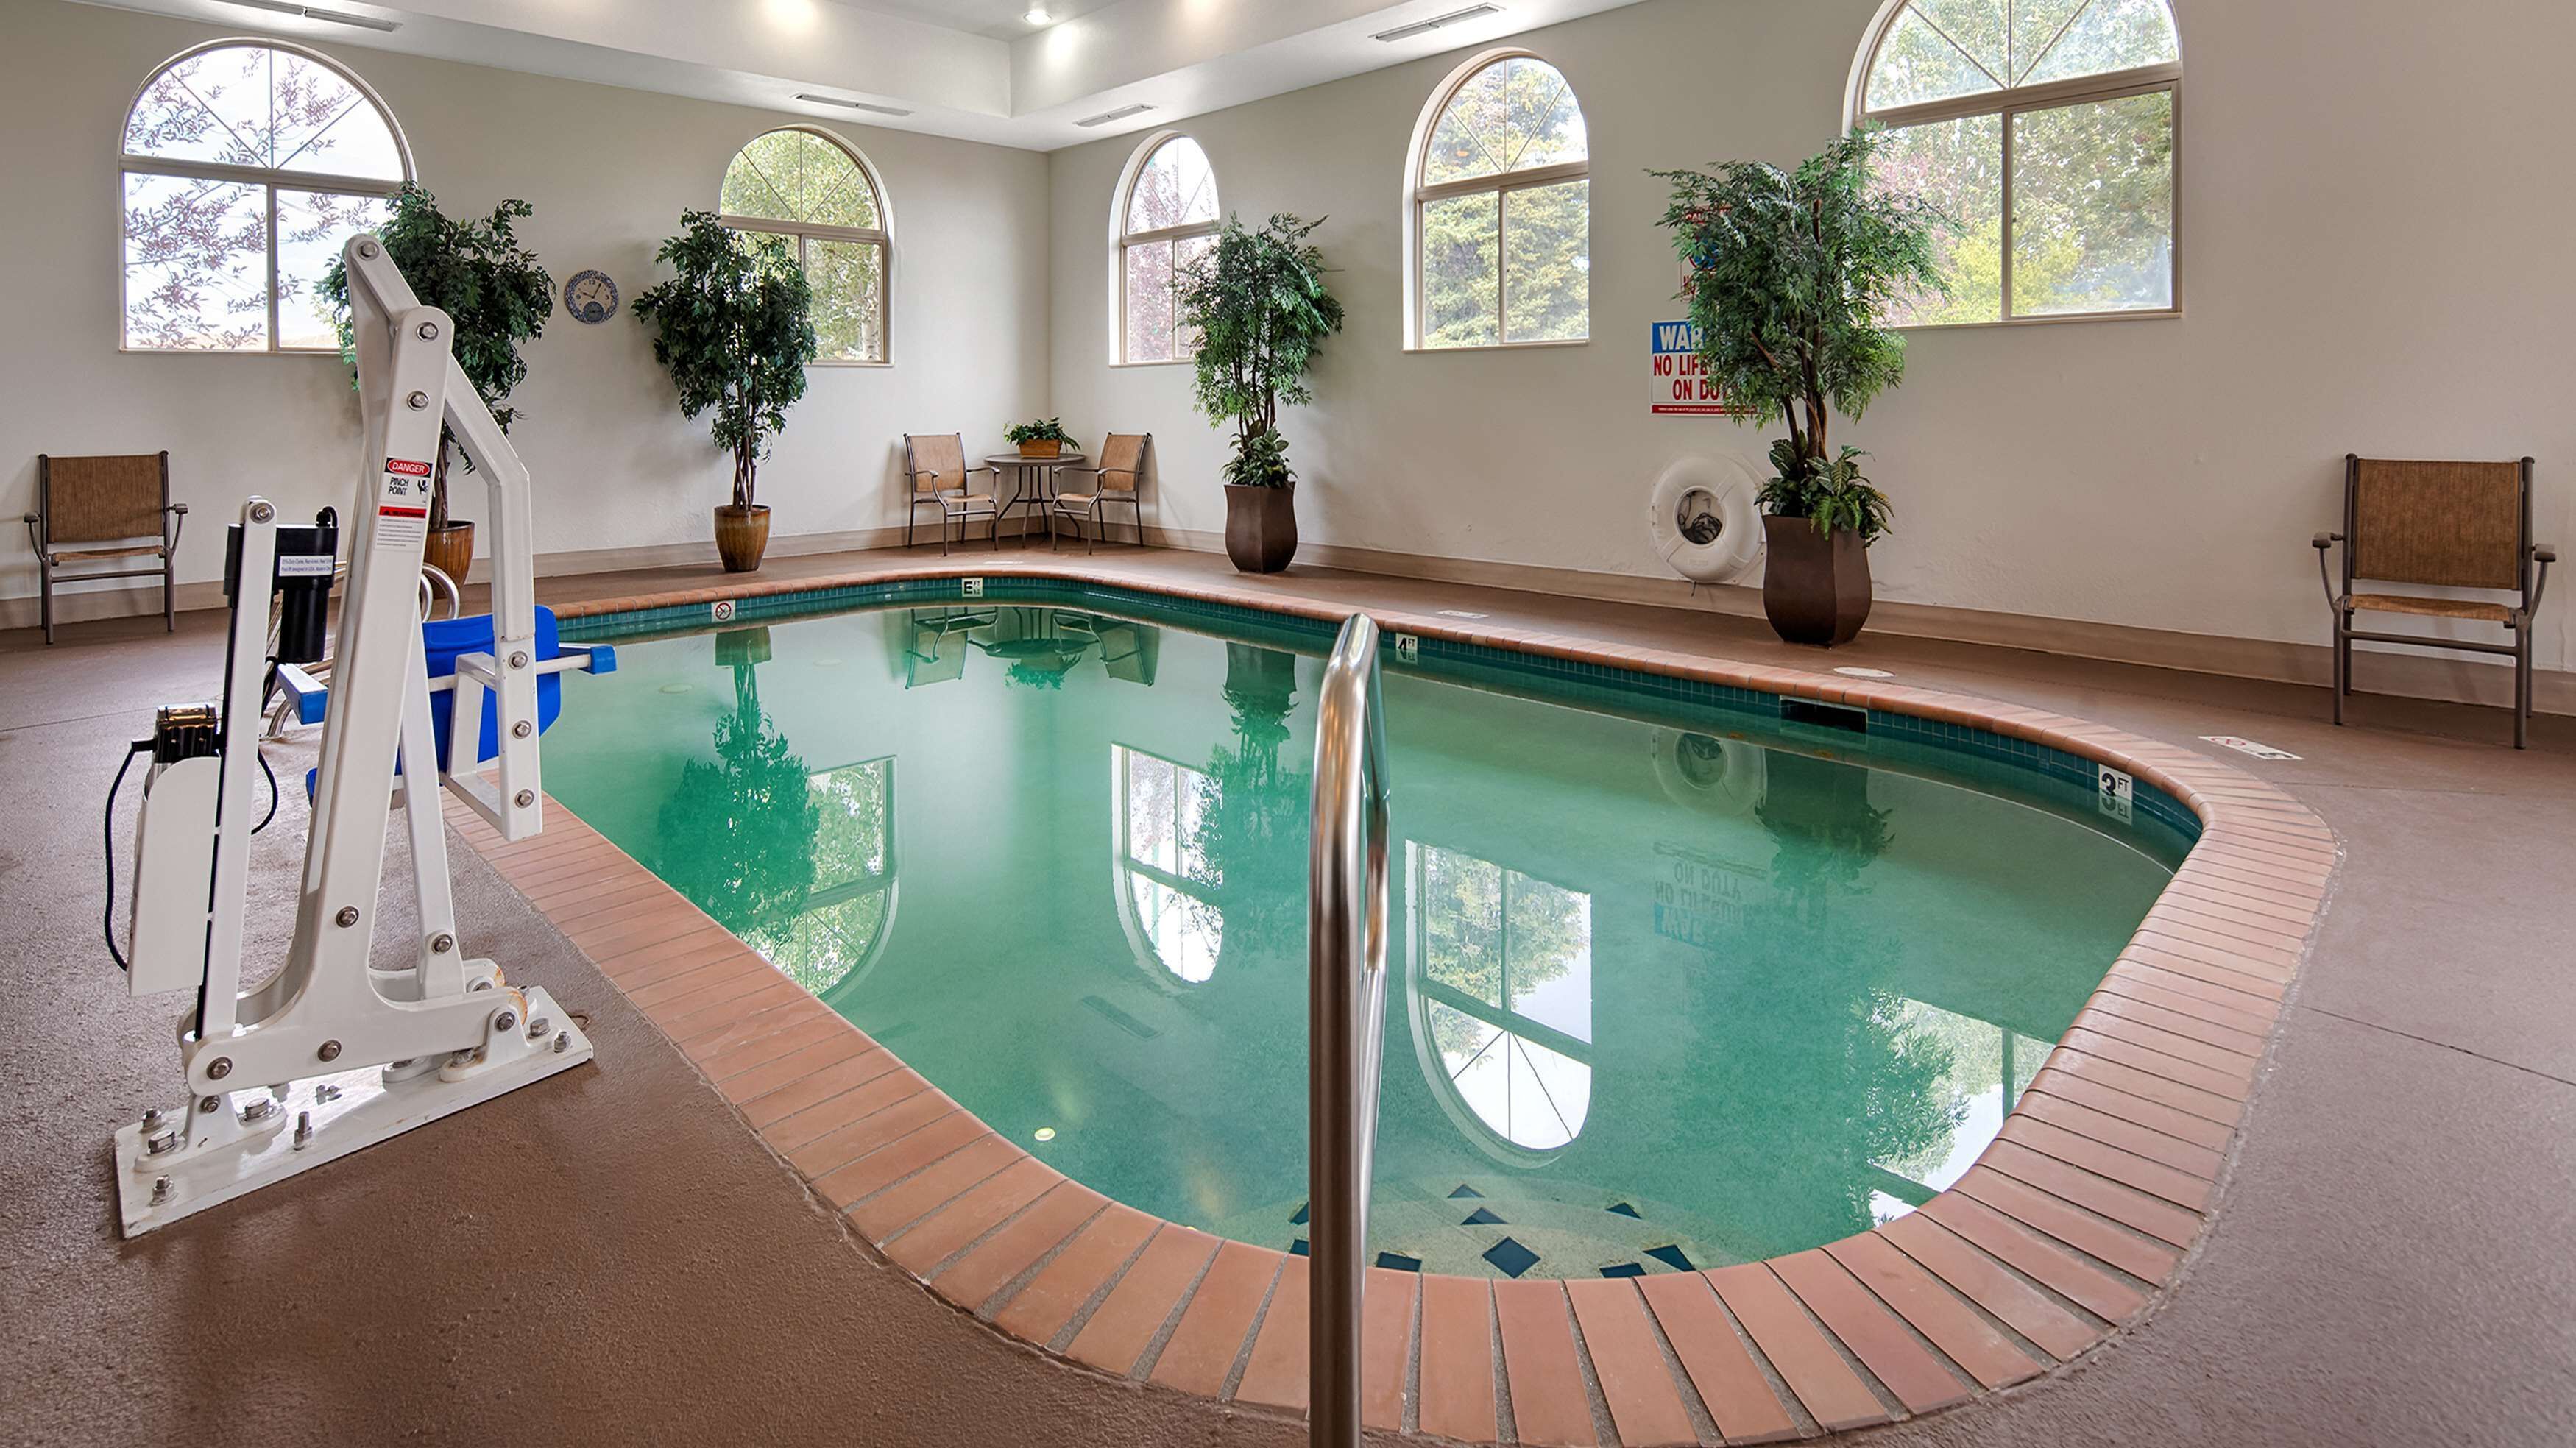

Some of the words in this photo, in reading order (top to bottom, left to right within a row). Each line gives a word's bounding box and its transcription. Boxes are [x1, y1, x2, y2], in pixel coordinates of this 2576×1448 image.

[1654, 355, 1672, 376] NO
[1672, 379, 1692, 400] ON
[1699, 379, 1732, 400] DU
[392, 462, 425, 473] DANGER
[390, 477, 409, 486] PINCH
[388, 486, 408, 496] POINT
[1408, 638, 1415, 647] FT
[2101, 773, 2116, 796] 3
[2118, 777, 2129, 792] FT
